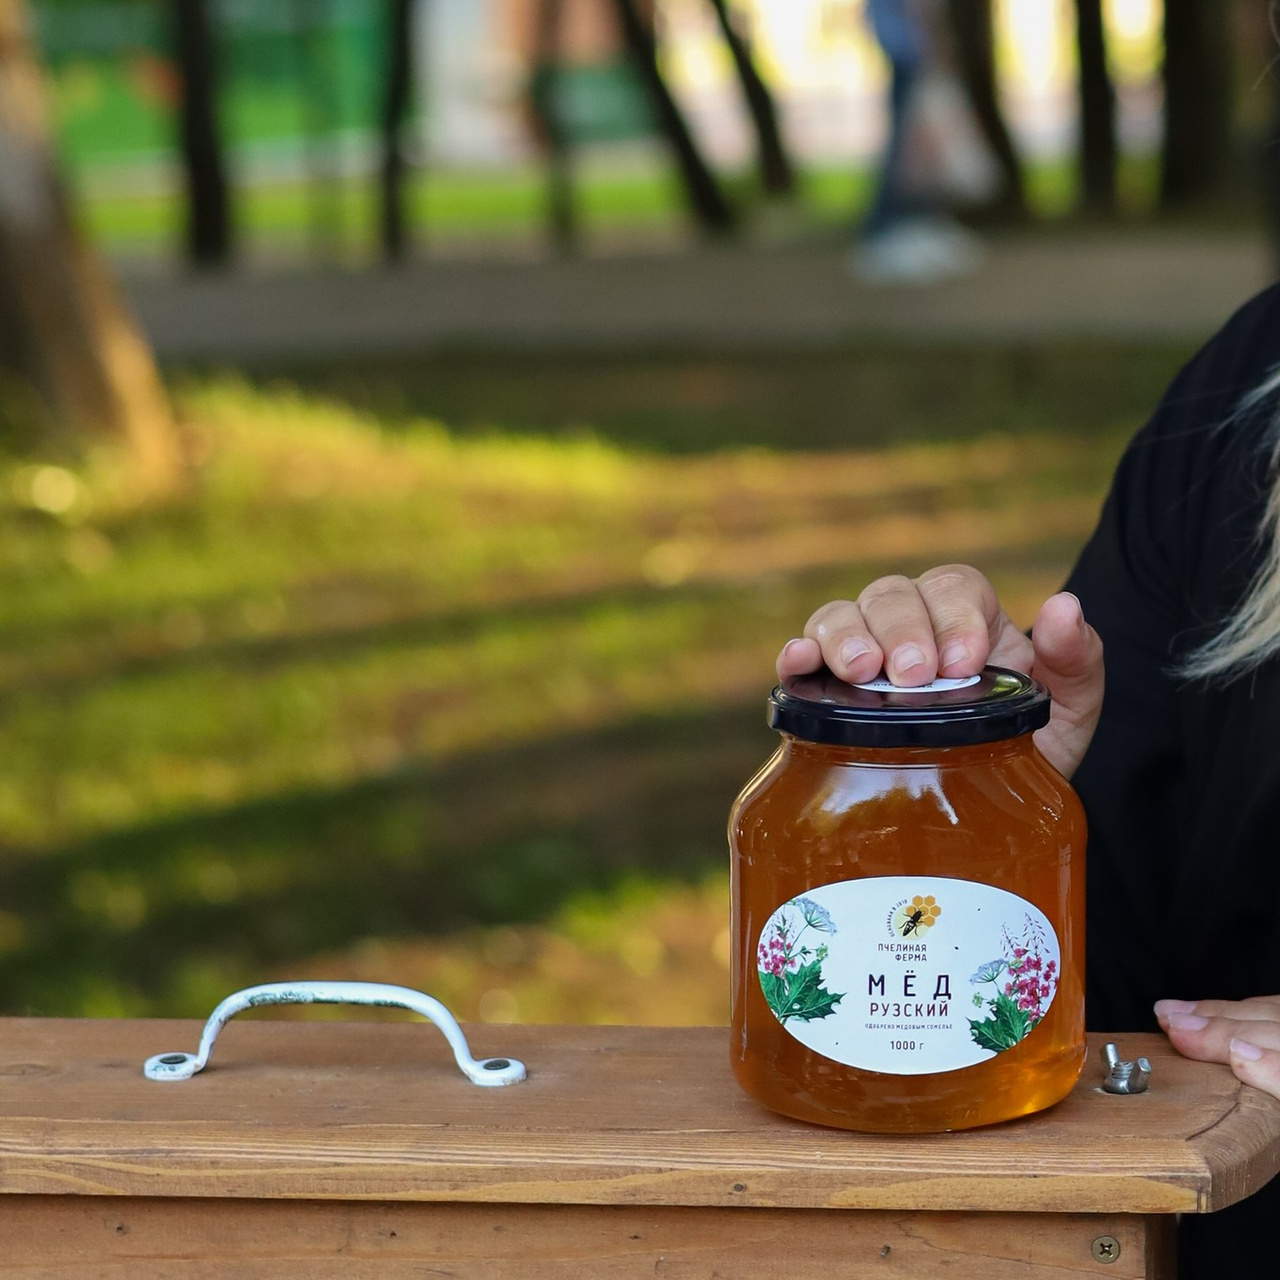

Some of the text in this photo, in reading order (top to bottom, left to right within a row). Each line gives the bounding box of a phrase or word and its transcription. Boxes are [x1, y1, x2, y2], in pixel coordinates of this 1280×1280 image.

[878, 943, 927, 952] ПЧЕЛИНАЯ
[895, 953, 927, 962] ФЕРМА
[868, 970, 952, 1000] МЁД
[870, 1000, 948, 1017] РУЗСКИЙ
[890, 1041, 916, 1050] 1000
